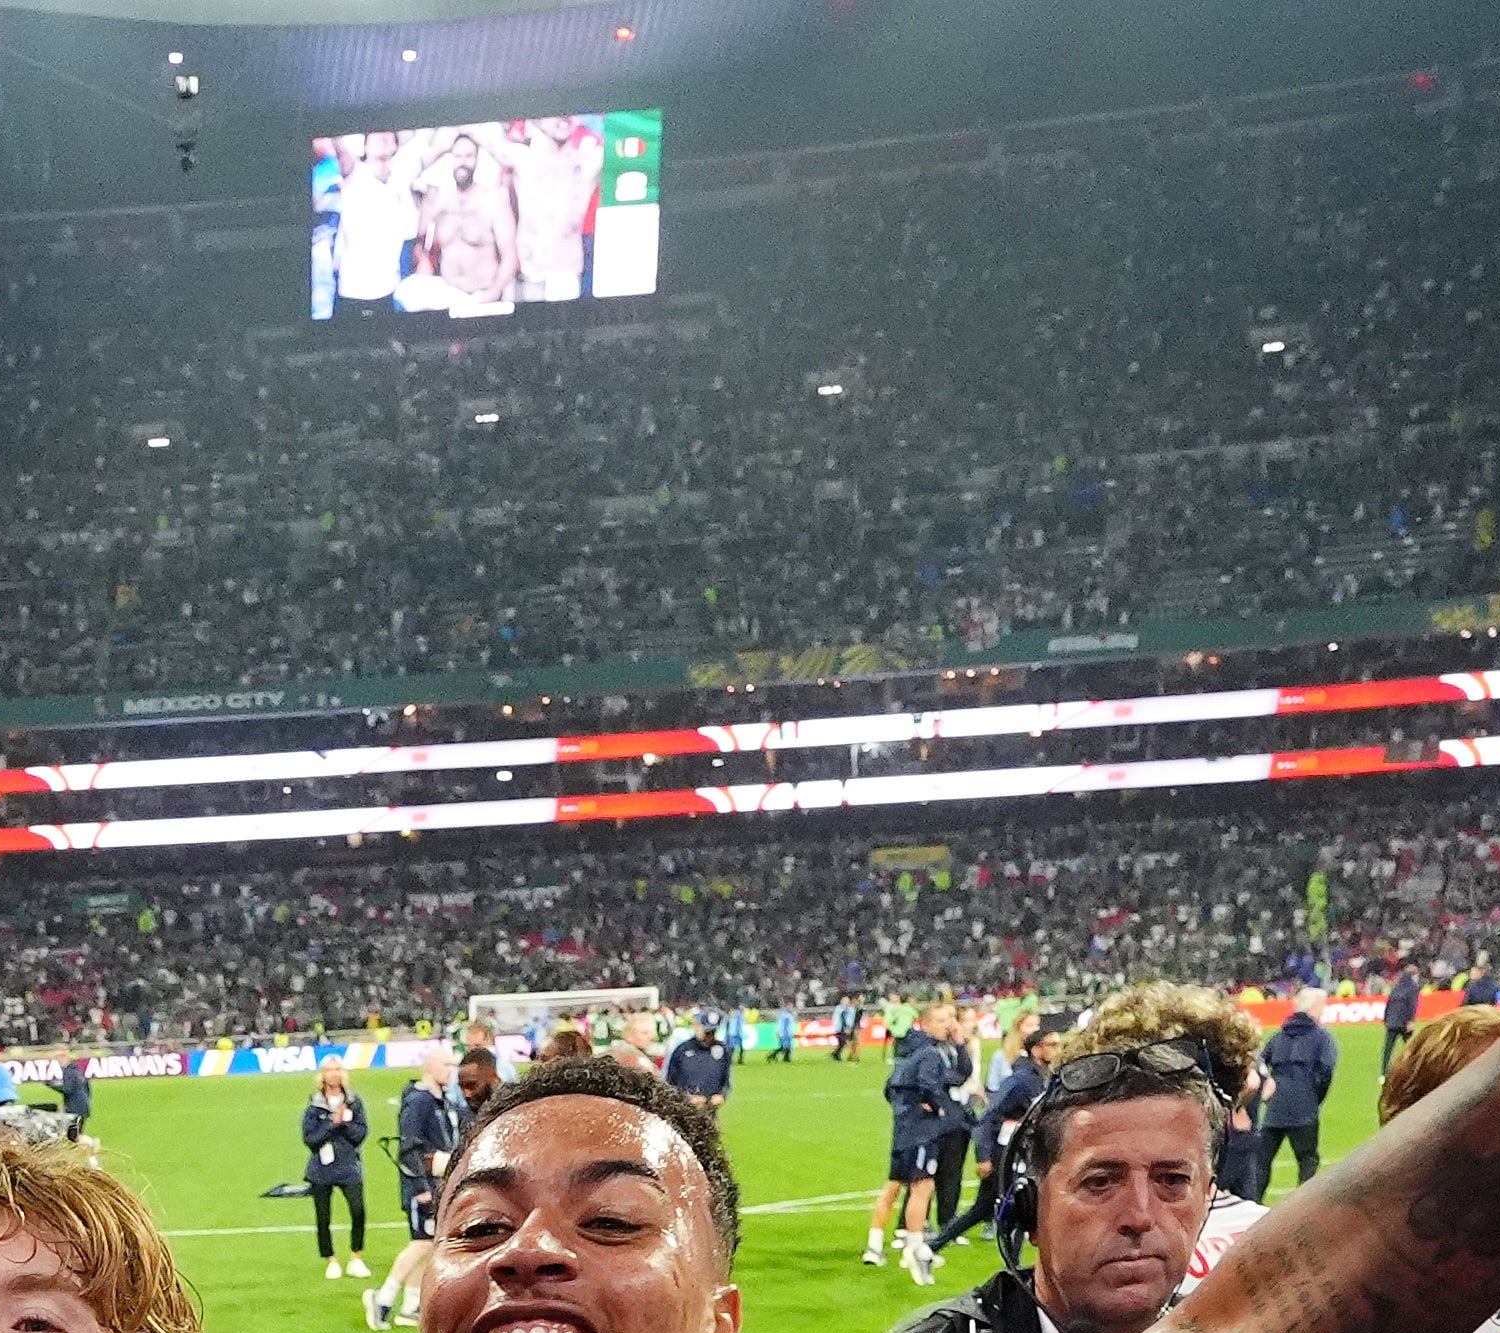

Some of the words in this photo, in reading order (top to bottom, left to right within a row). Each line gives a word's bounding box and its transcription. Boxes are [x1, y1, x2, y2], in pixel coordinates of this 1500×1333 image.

[5, 1059, 63, 1084] QATA
[83, 1052, 184, 1080] AIRWAYS
[256, 1045, 317, 1074] VISA
